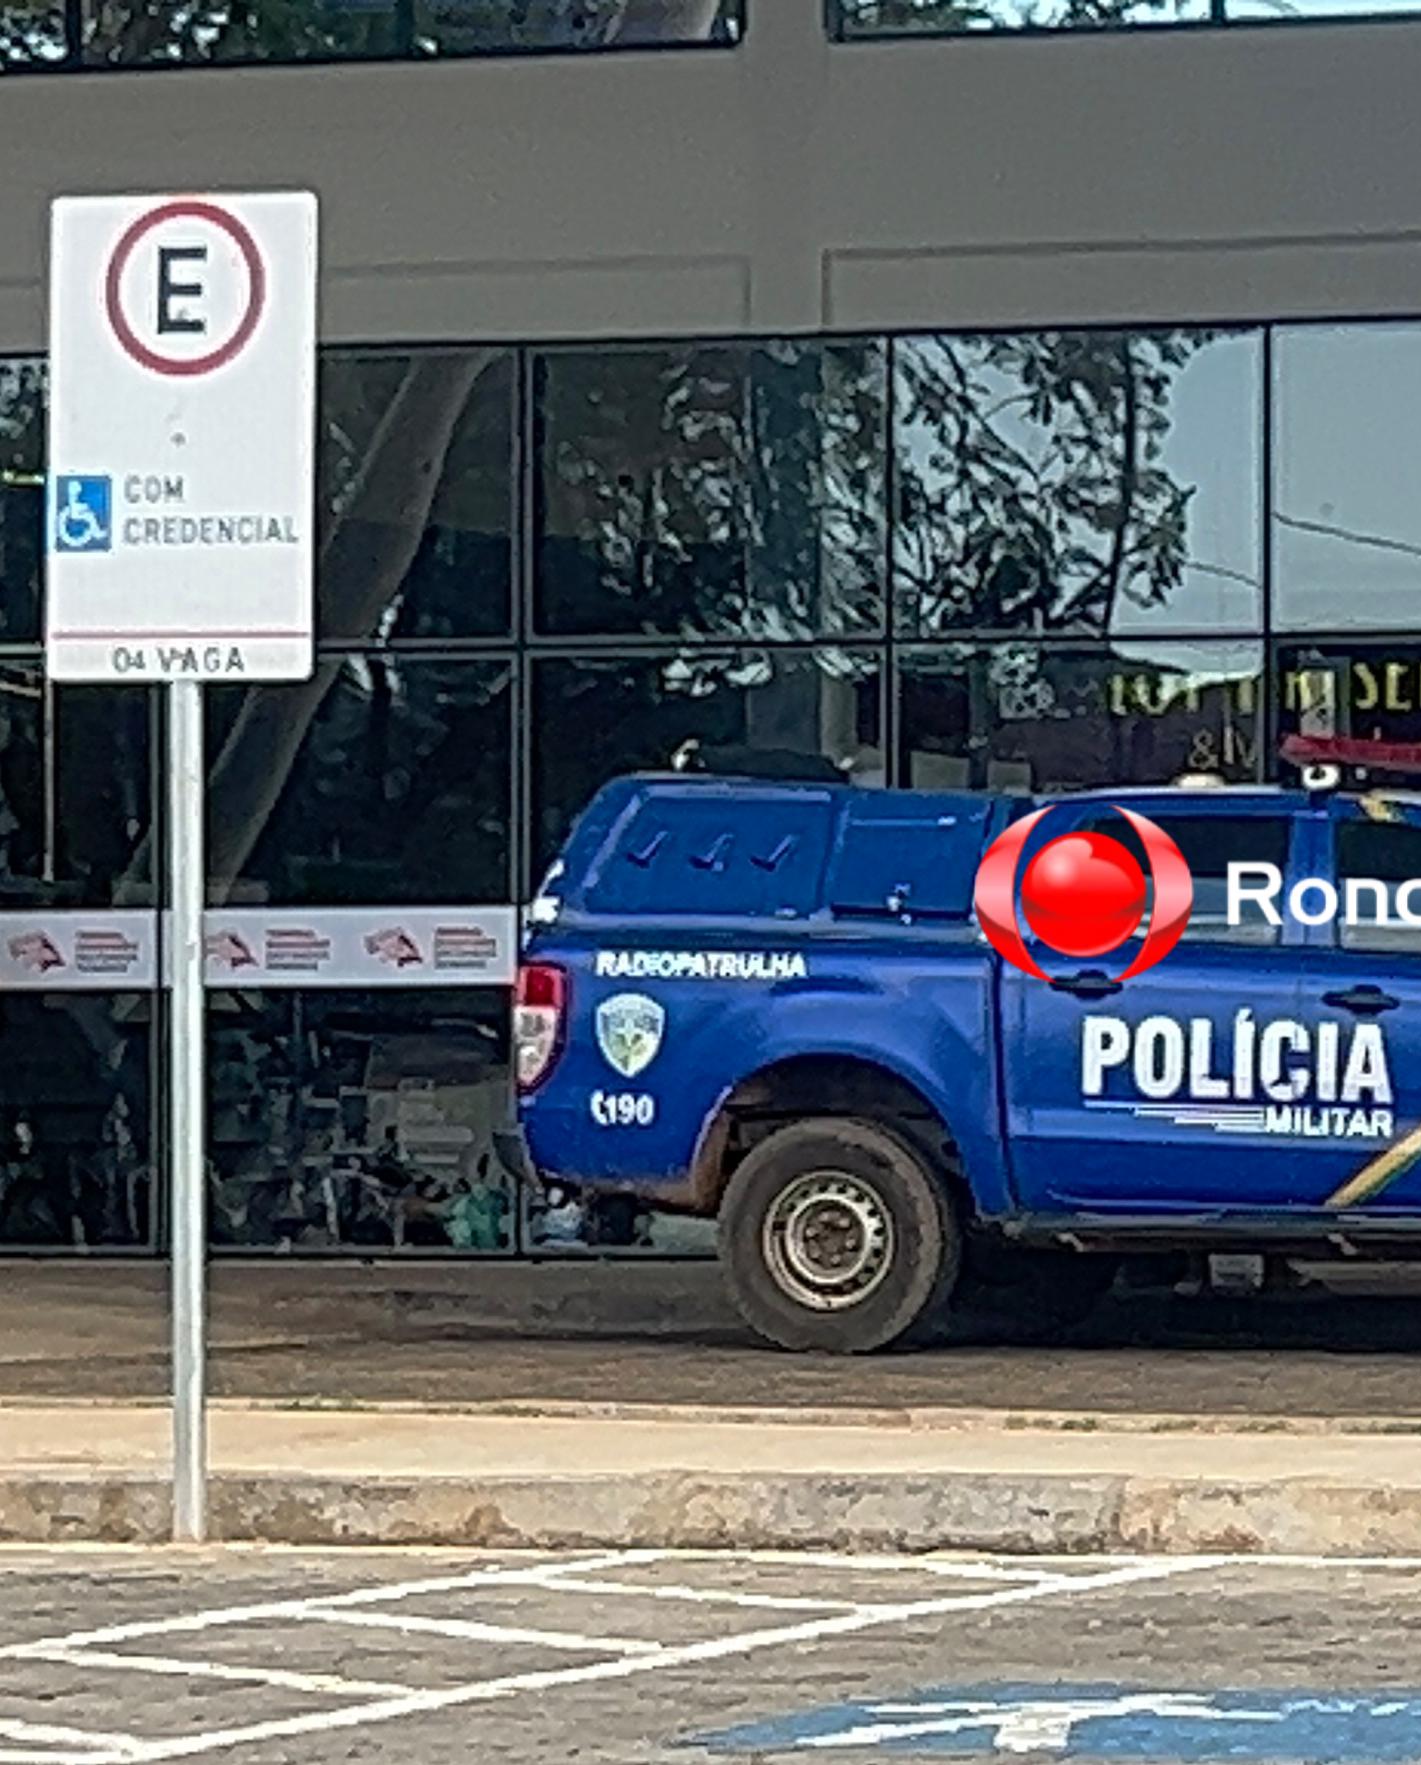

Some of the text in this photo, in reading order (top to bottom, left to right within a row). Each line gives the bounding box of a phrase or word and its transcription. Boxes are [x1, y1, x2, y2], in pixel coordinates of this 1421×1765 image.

[156, 245, 208, 335] E
[122, 475, 186, 504] COM
[122, 516, 300, 545] CREDENCIAL
[112, 646, 246, 674] 04 VAGA
[1081, 1009, 1394, 1105] POLÍCIA
[606, 1094, 654, 1126] 190
[1263, 1107, 1393, 1138] MILITAR
